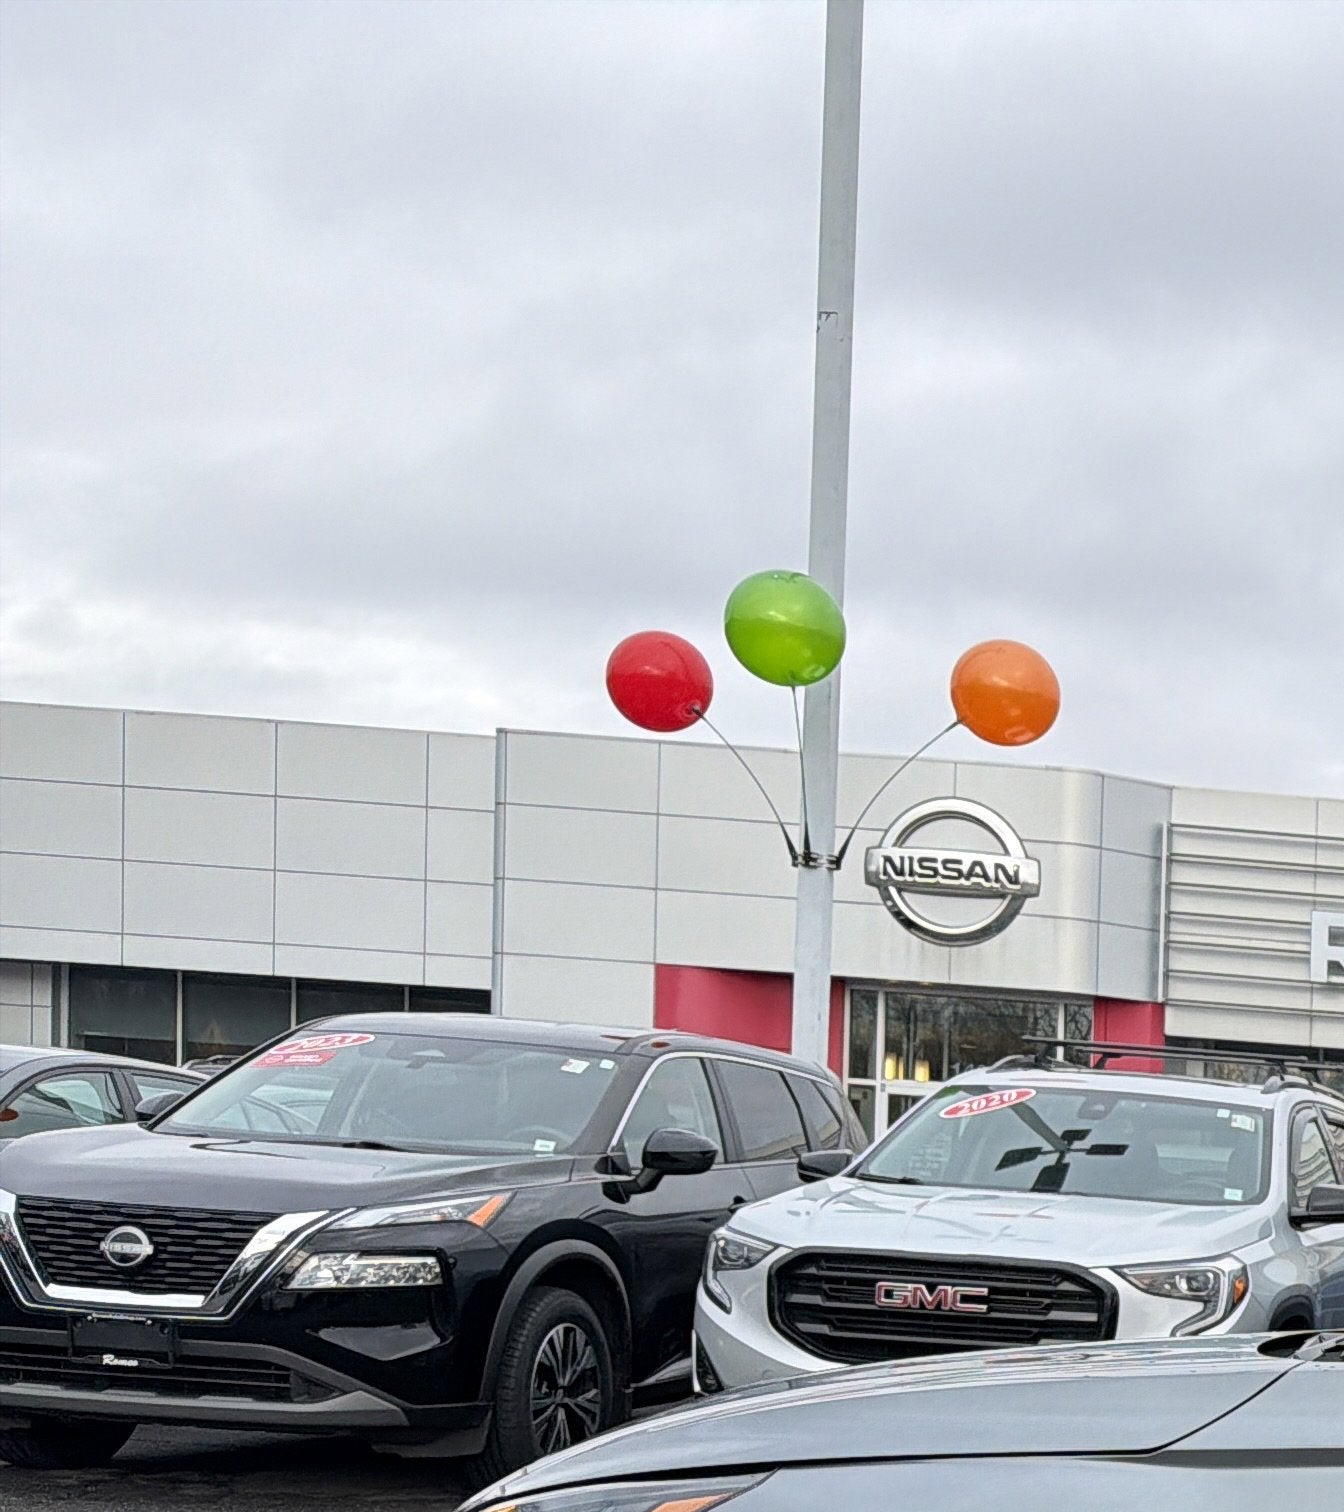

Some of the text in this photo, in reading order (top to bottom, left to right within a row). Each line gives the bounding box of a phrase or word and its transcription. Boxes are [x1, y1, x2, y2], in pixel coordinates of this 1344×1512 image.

[880, 855, 1021, 887] NISSAN
[959, 1091, 1018, 1113] 2020
[875, 1281, 988, 1312] GMC
